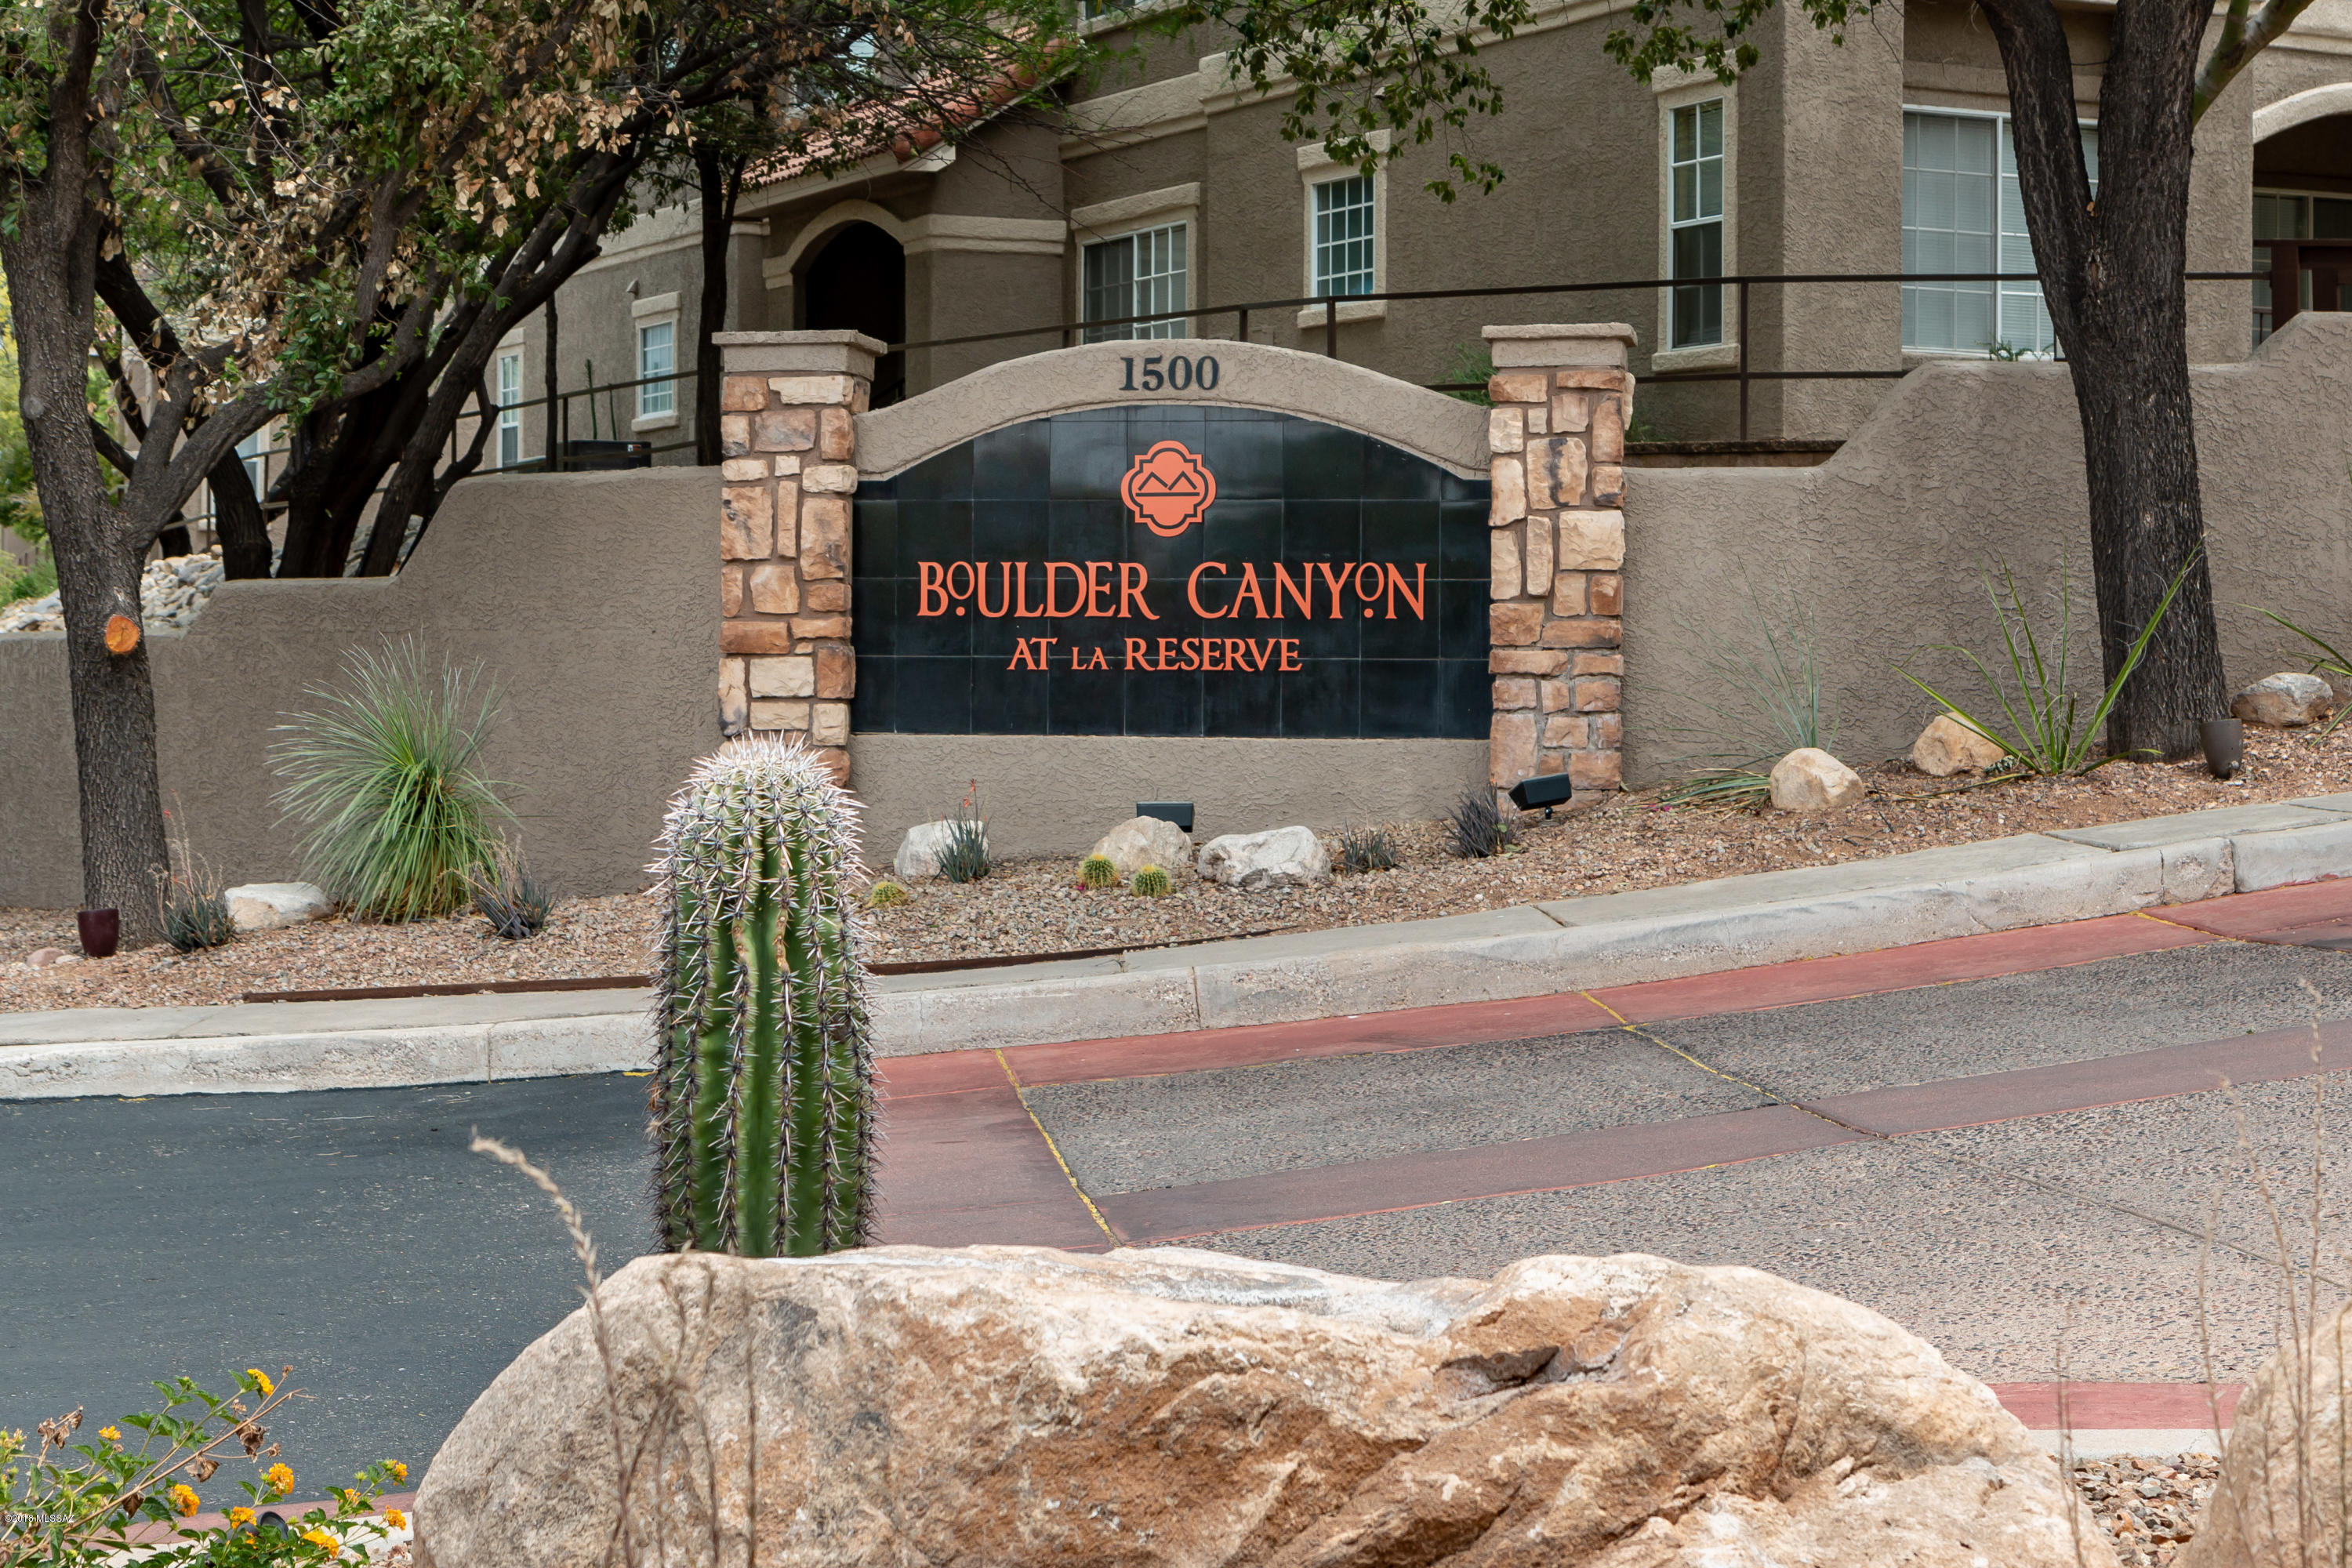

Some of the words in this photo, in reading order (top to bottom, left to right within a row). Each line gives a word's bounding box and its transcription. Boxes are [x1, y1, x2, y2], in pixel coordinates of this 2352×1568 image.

[1119, 354, 1219, 391] 1500
[916, 561, 1160, 621] BOULDER
[1187, 561, 1428, 621] CANYON
[1007, 637, 1058, 671] AT
[1071, 646, 1110, 671] LA
[1123, 637, 1303, 672] RESERVE
